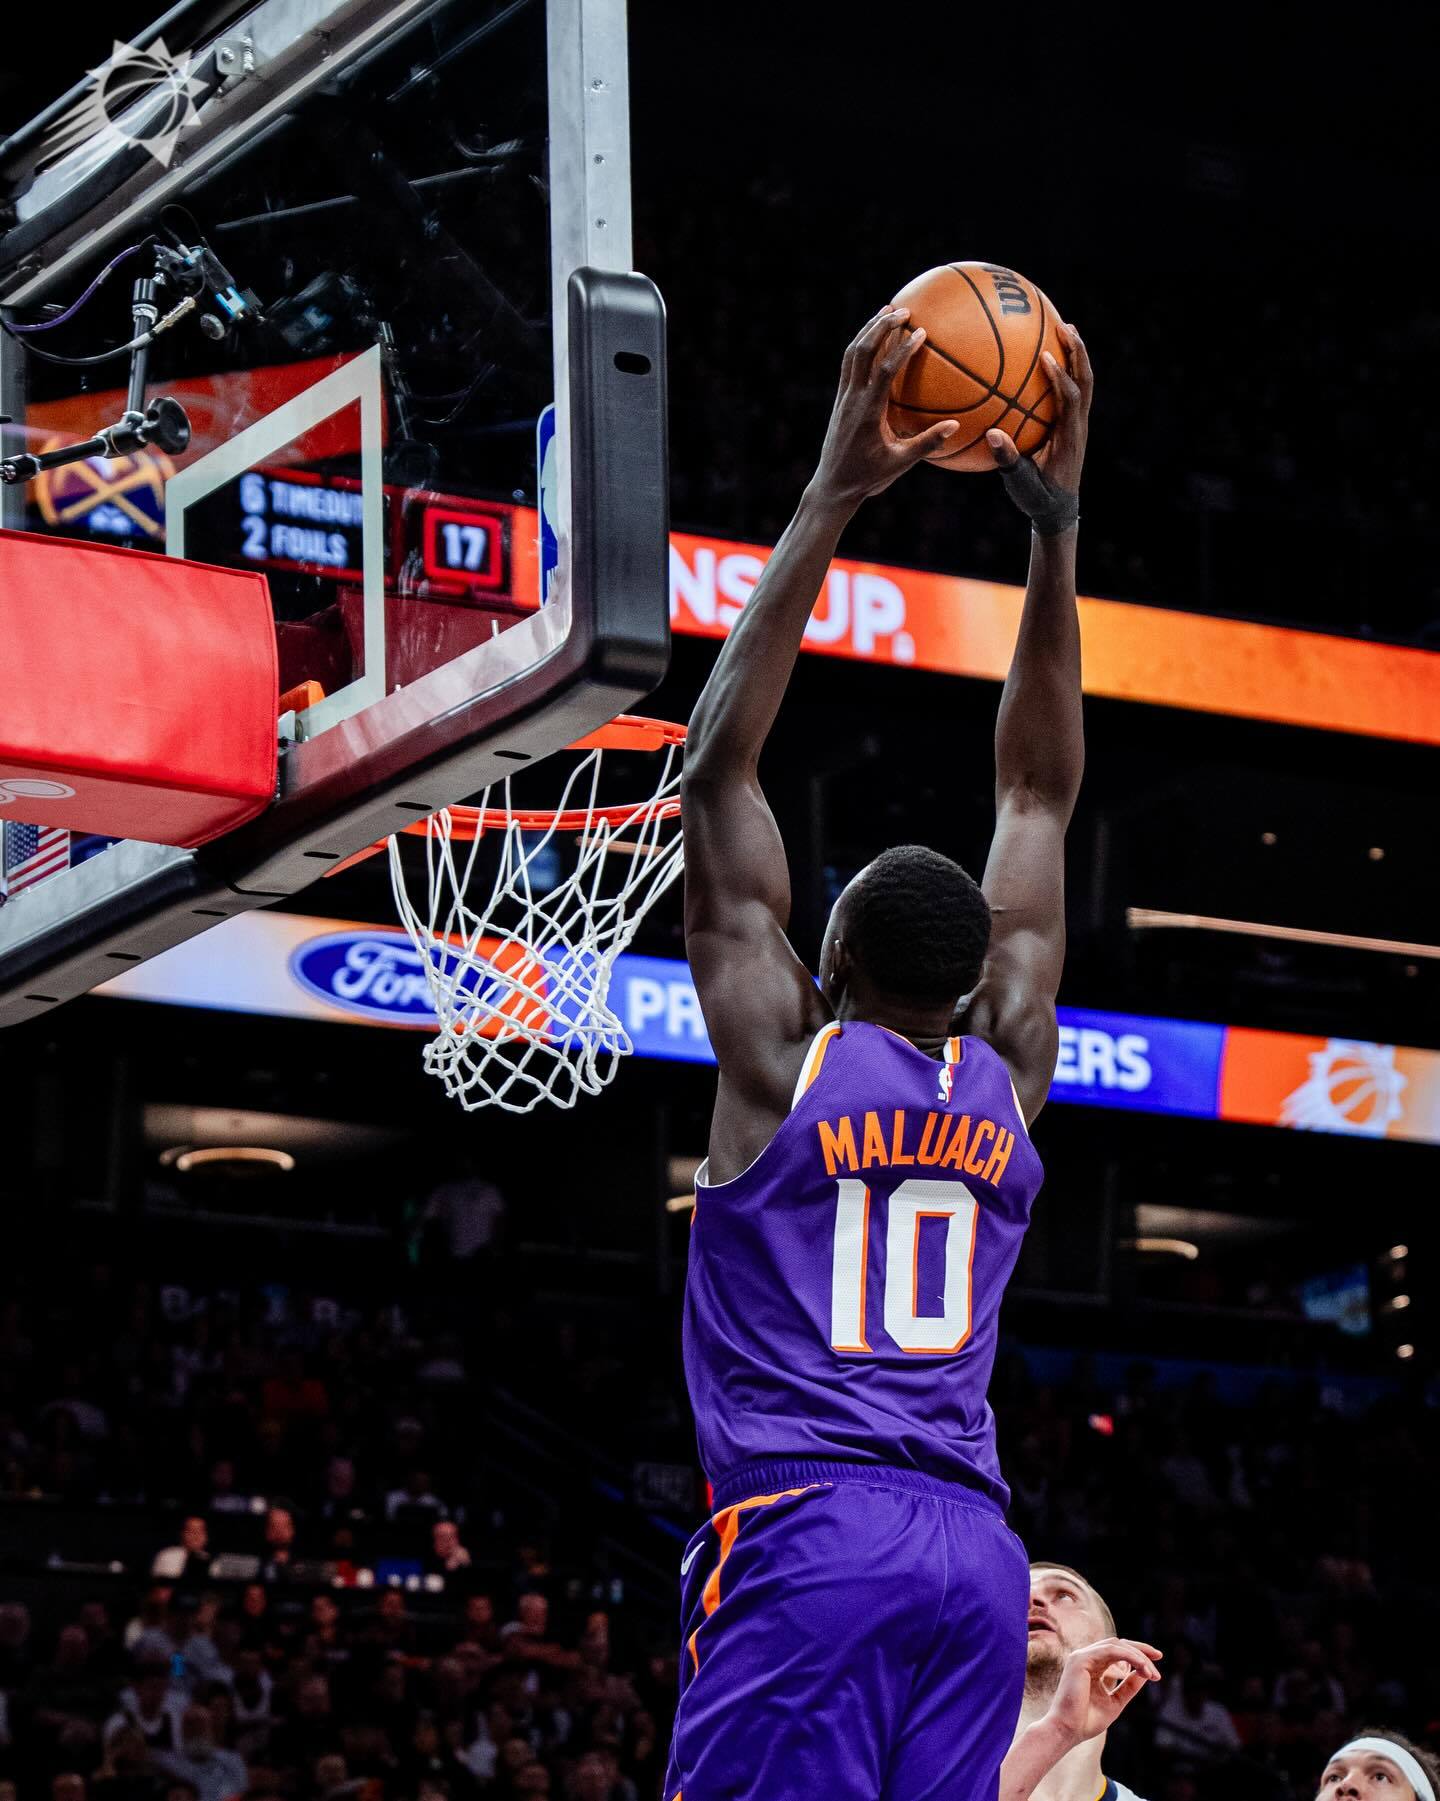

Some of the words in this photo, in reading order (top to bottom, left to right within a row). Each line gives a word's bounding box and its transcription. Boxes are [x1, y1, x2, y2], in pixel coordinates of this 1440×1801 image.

[240, 473, 266, 514] 6
[241, 515, 267, 559] 2
[271, 523, 349, 567] FOULS
[442, 523, 487, 570] 17
[817, 1110, 1014, 1187] MALUACH
[831, 1179, 979, 1354] 10
